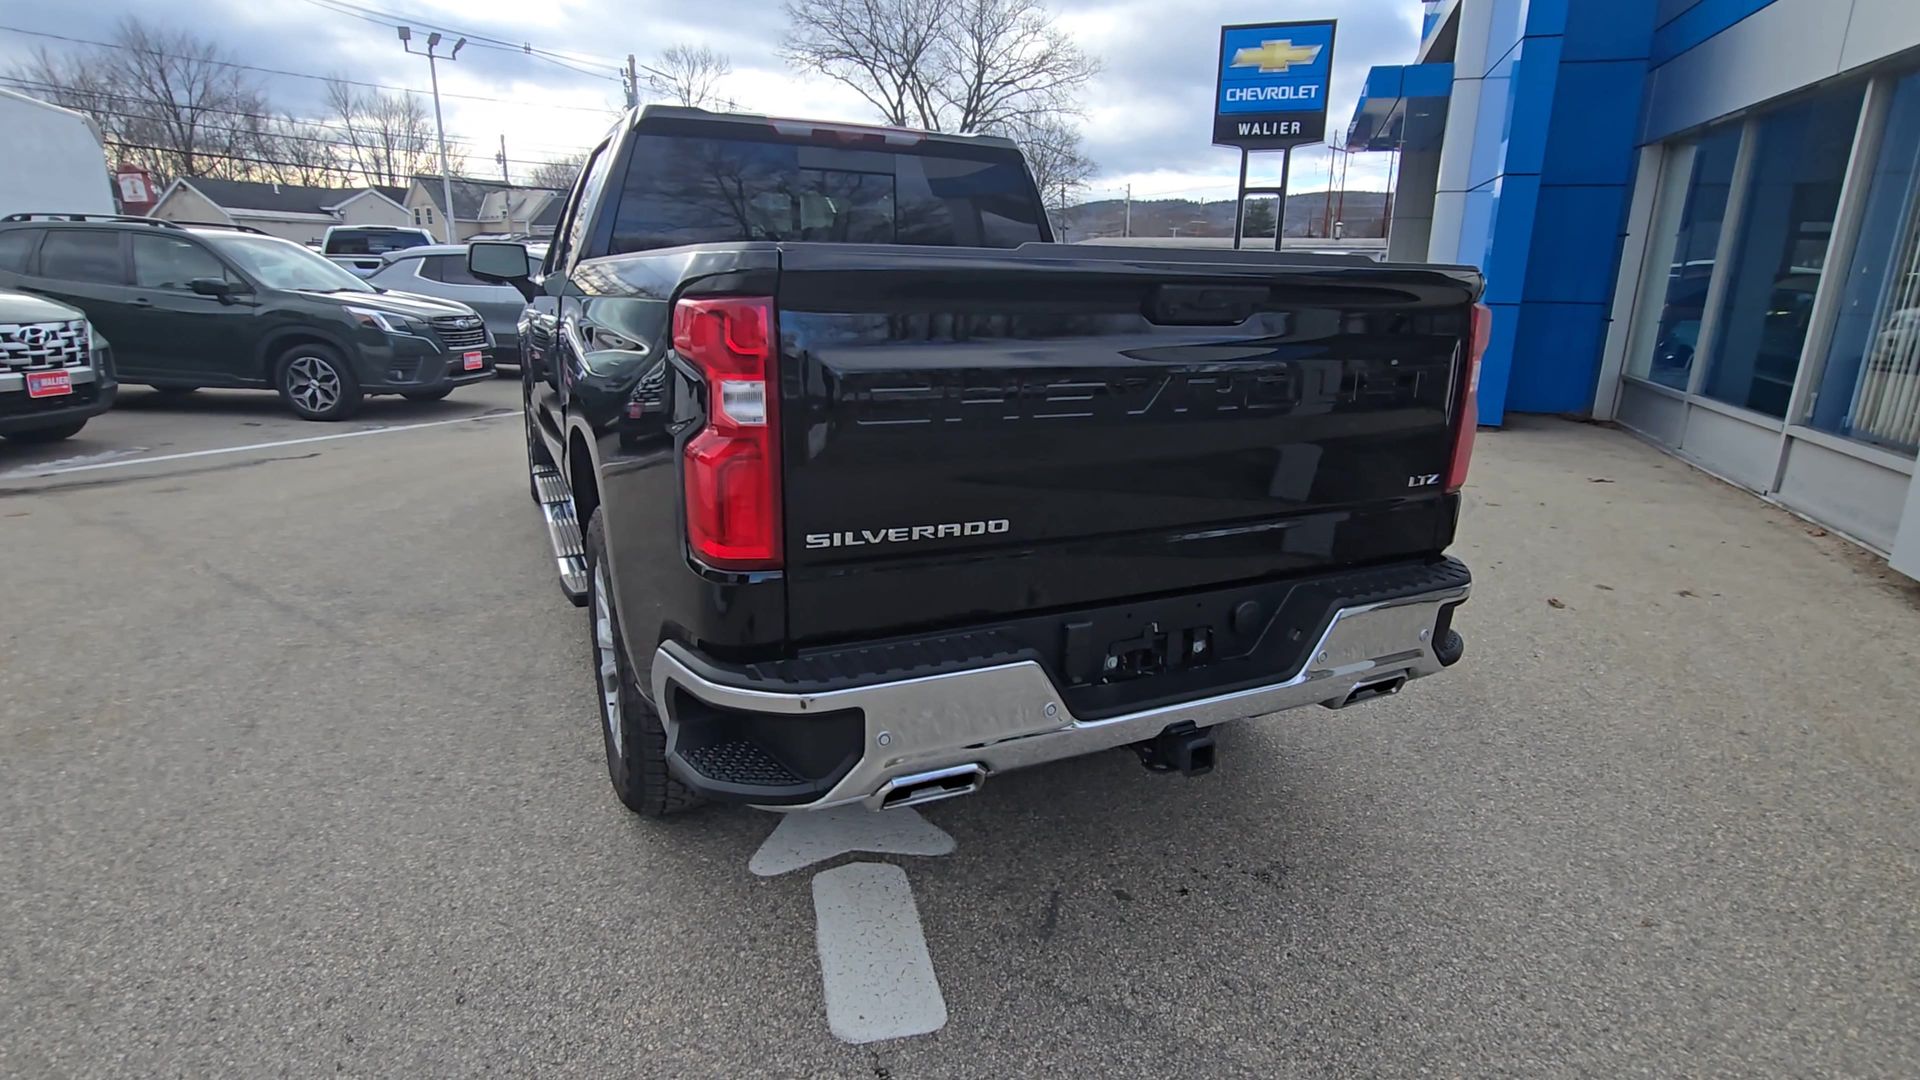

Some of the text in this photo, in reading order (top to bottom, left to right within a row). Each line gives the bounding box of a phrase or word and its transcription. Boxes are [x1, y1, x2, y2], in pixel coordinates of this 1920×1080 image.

[1226, 84, 1319, 102] CHEVROLET
[1238, 121, 1301, 136] WALIER
[1407, 473, 1440, 488] LTZ
[805, 518, 1010, 549] SILVERADO
